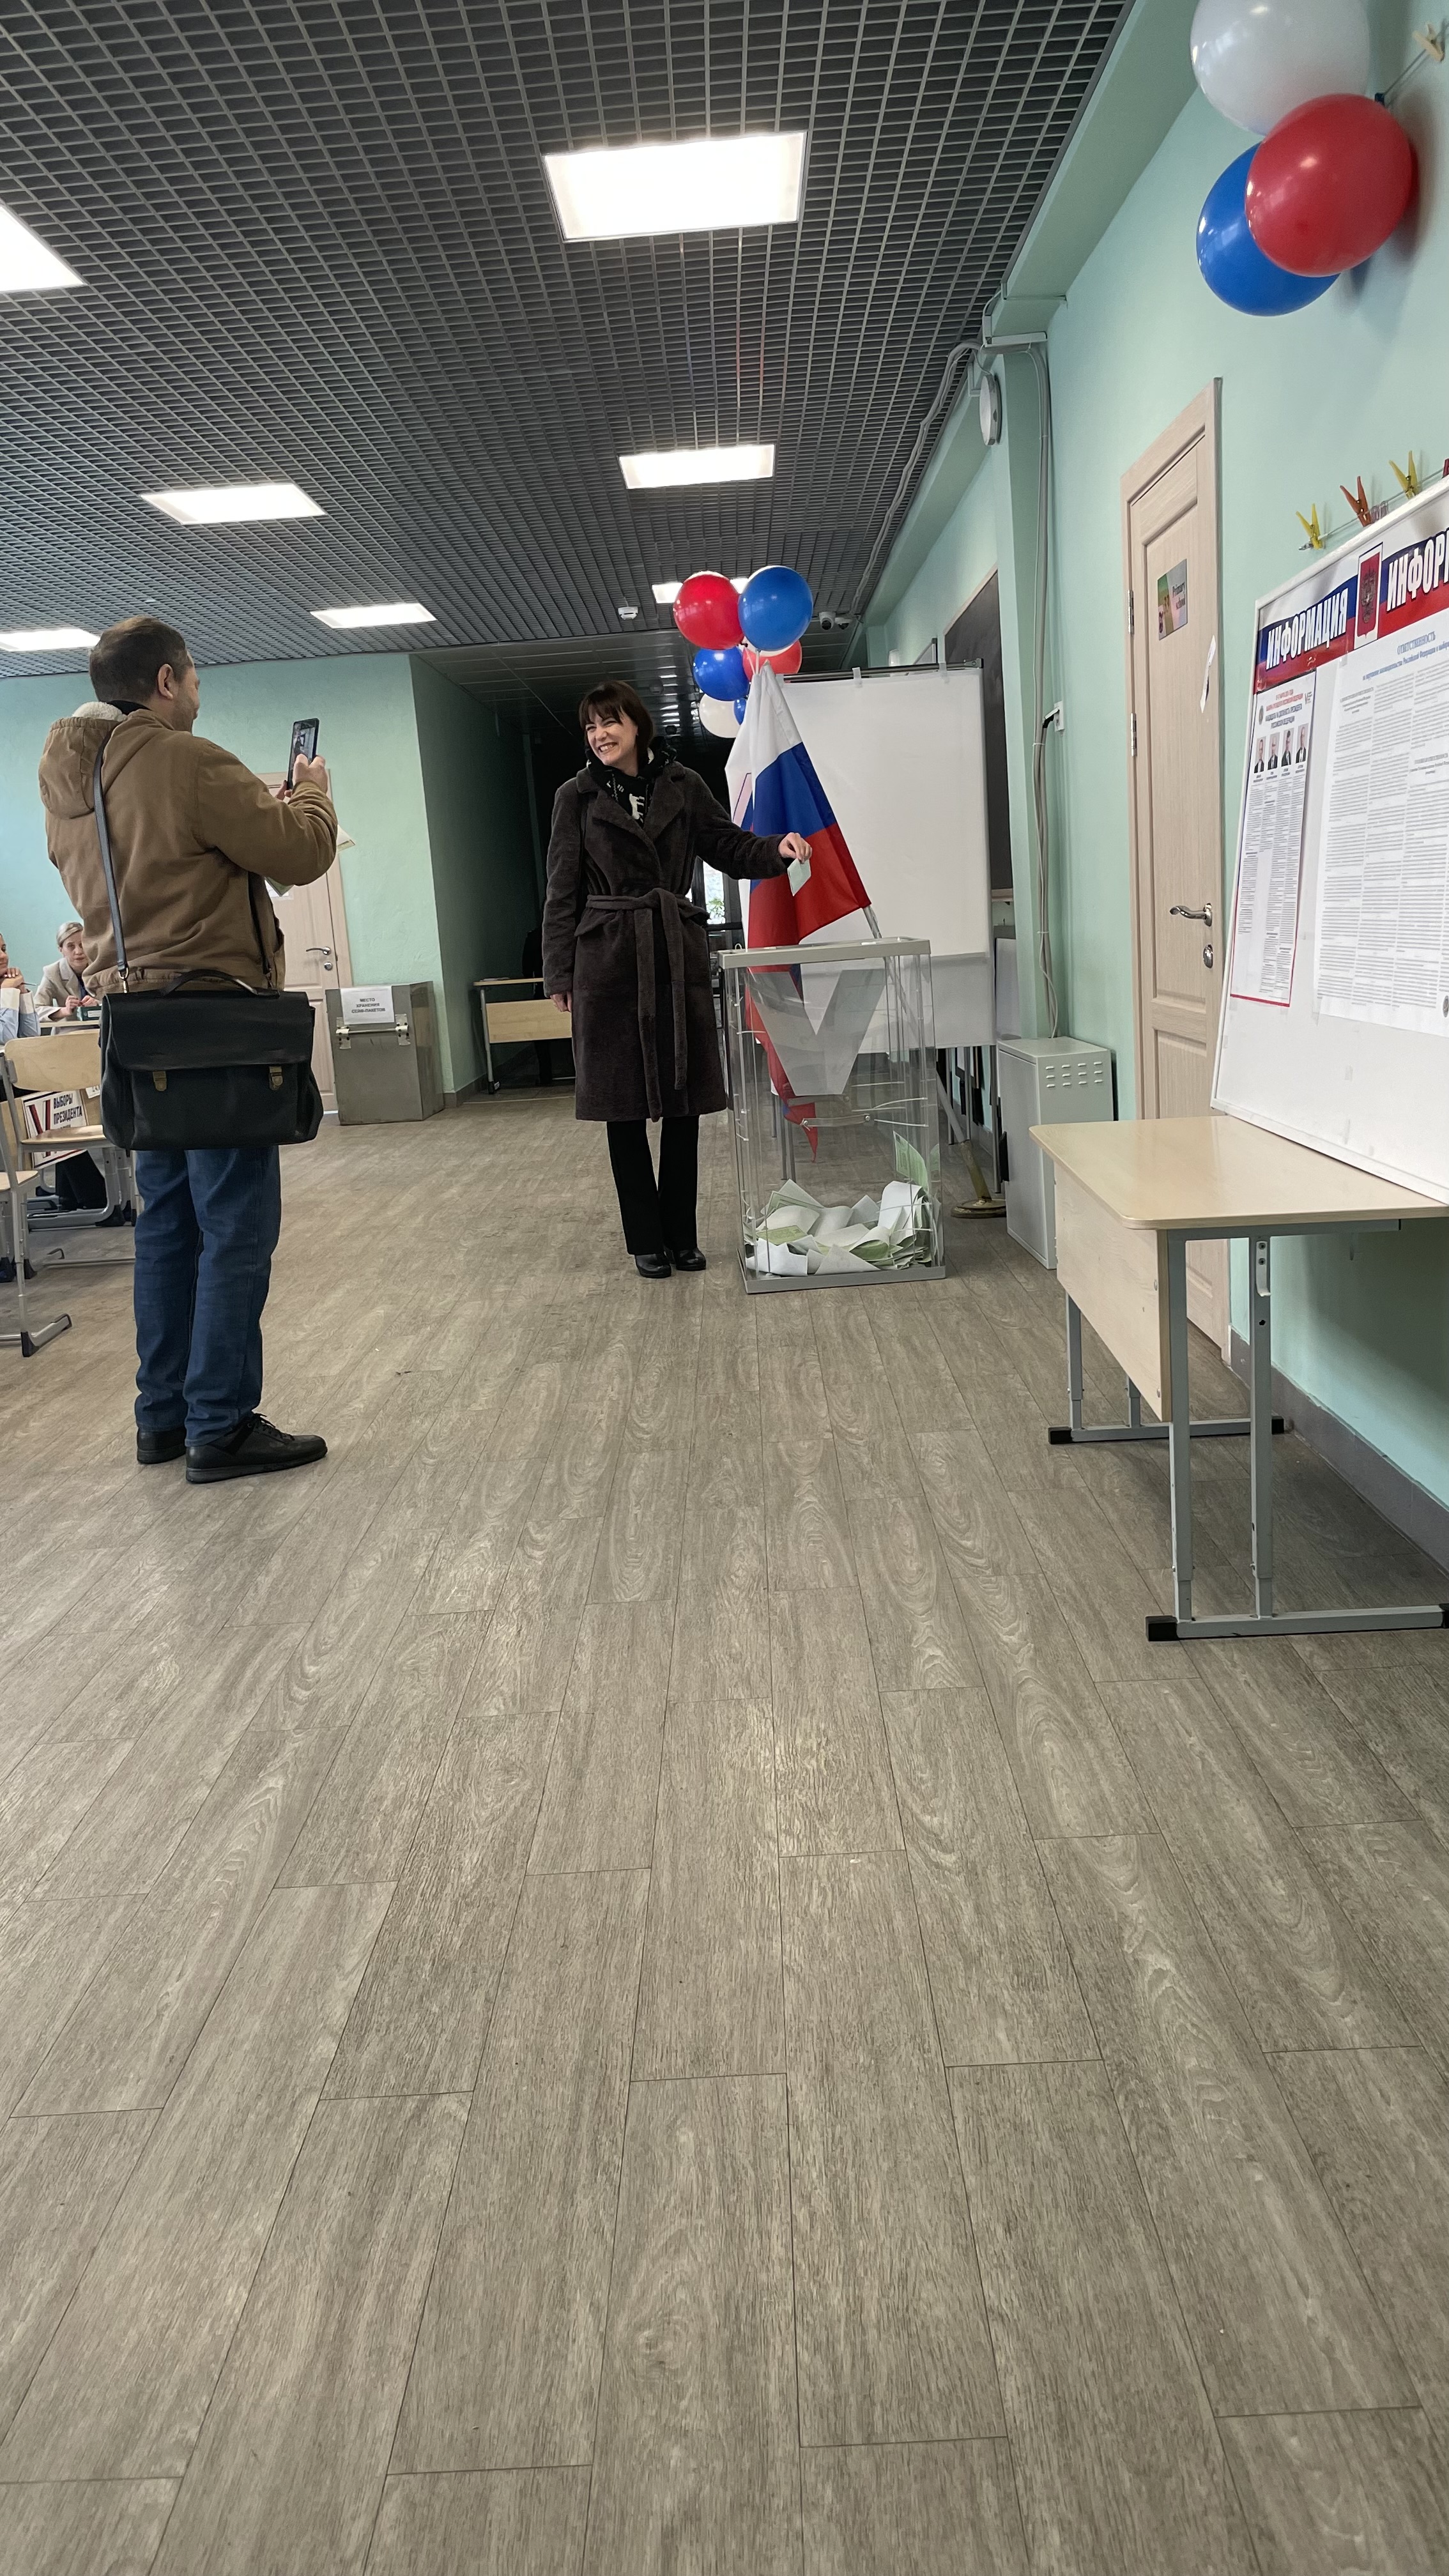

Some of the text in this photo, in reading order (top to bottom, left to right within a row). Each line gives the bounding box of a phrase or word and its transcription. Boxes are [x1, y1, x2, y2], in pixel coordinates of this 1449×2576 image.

[1386, 529, 1449, 611] ИНФОР
[1172, 582, 1185, 598] Primary
[1266, 587, 1349, 670] ИНФОРМАЦИЯ
[54, 1092, 73, 1110] ВЫБОРЫ
[53, 1105, 83, 1125] ПРЕЗИДЕНТА
